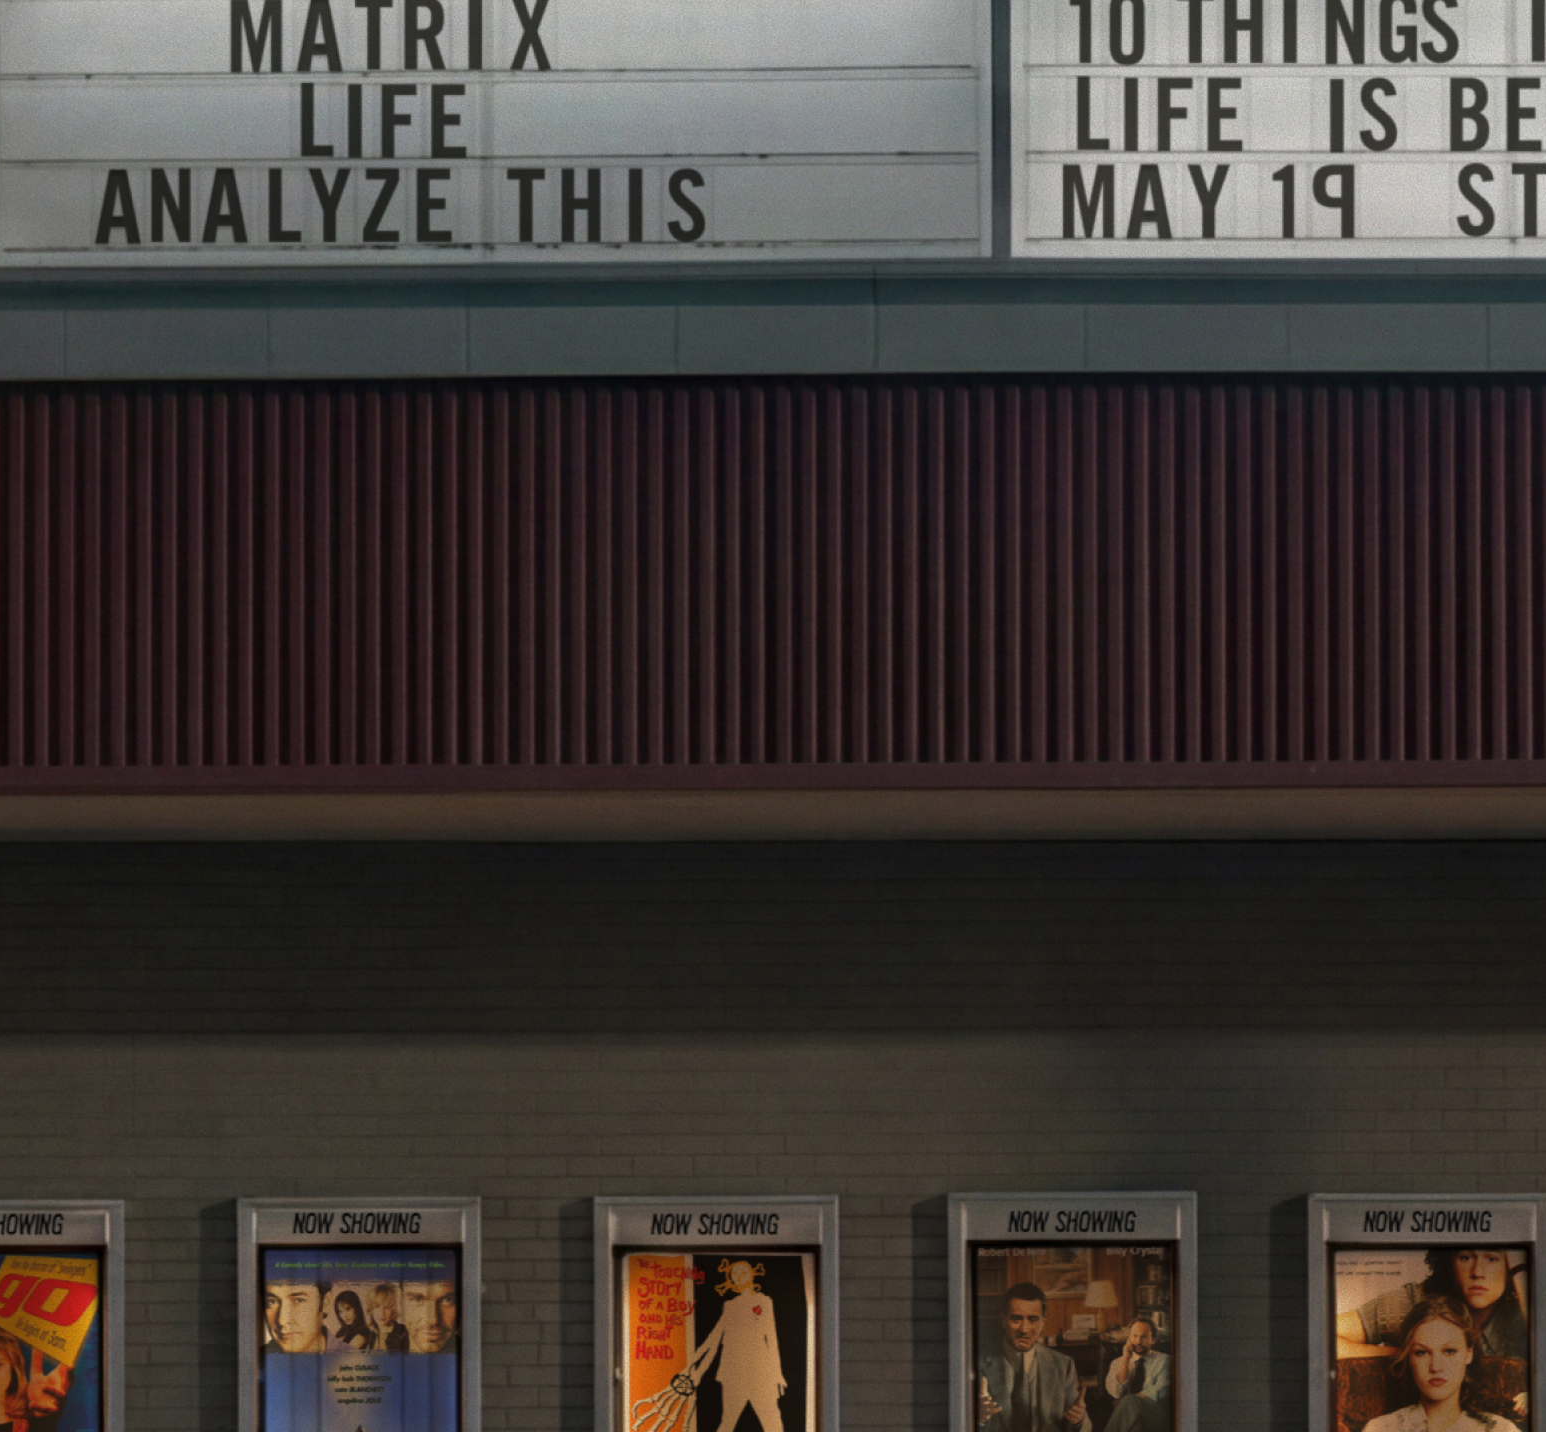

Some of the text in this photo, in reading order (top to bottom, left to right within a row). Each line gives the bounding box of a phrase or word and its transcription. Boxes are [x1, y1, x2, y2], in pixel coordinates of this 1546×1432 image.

[229, 0, 553, 73] MATRIX
[1072, 0, 1146, 65] 10
[1185, 0, 1460, 65] THINGS
[1529, 0, 1546, 63] I
[300, 83, 468, 158] LIFE
[1075, 77, 1244, 152] LIFE
[1328, 77, 1399, 152] IS
[94, 168, 708, 245] ANALYZE THIS
[1061, 164, 1230, 240] MAY
[293, 1212, 421, 1234] NOW SHOWING
[650, 1213, 779, 1235] NOW SHOWING
[1008, 1210, 1137, 1232] NOW SHOWING
[1363, 1210, 1492, 1232] NOW SHOWING
